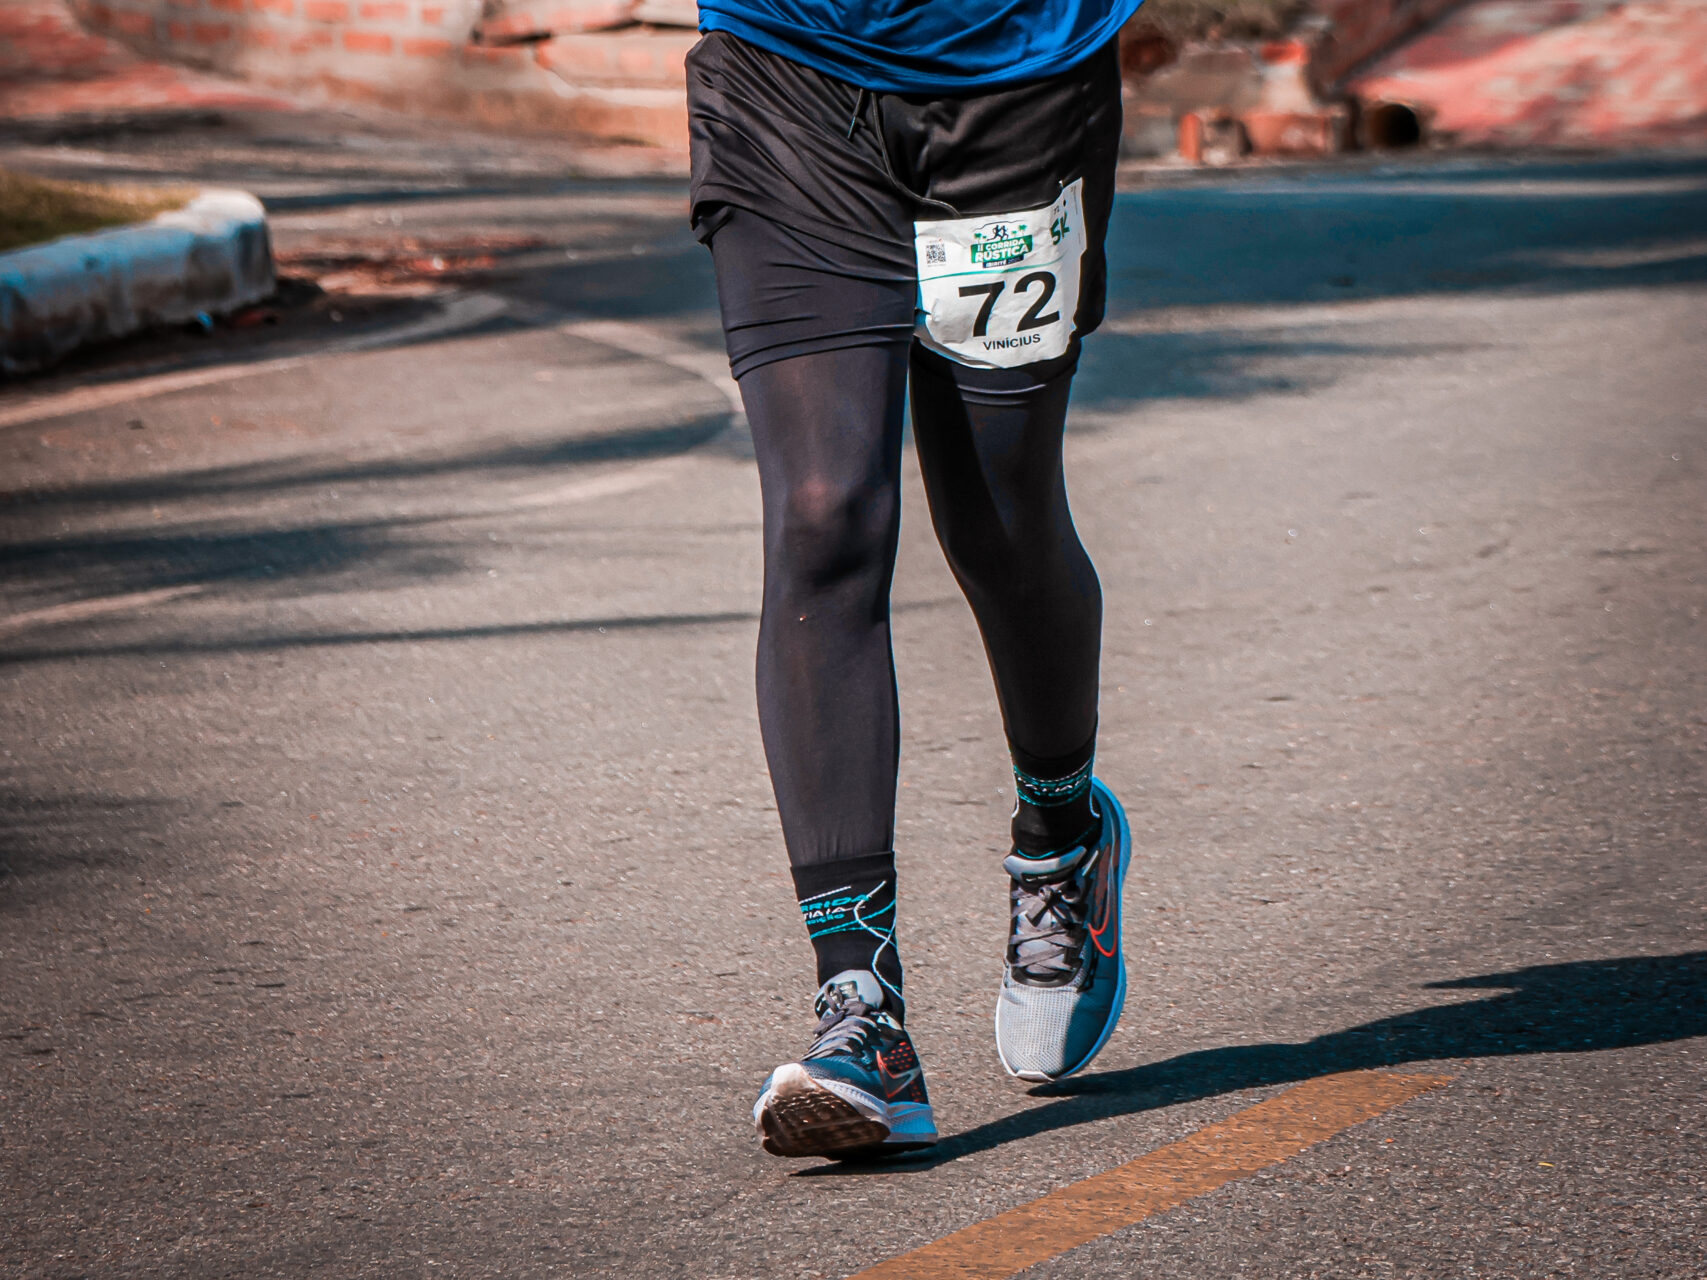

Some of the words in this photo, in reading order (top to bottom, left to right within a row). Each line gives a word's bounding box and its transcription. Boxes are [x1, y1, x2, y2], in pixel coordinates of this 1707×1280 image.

[1049, 210, 1071, 246] 5K
[974, 244, 1029, 263] RÚSTICA
[985, 238, 1026, 250] CORRIDA
[958, 271, 1060, 338] 72
[983, 333, 1042, 351] VINÍCIUS
